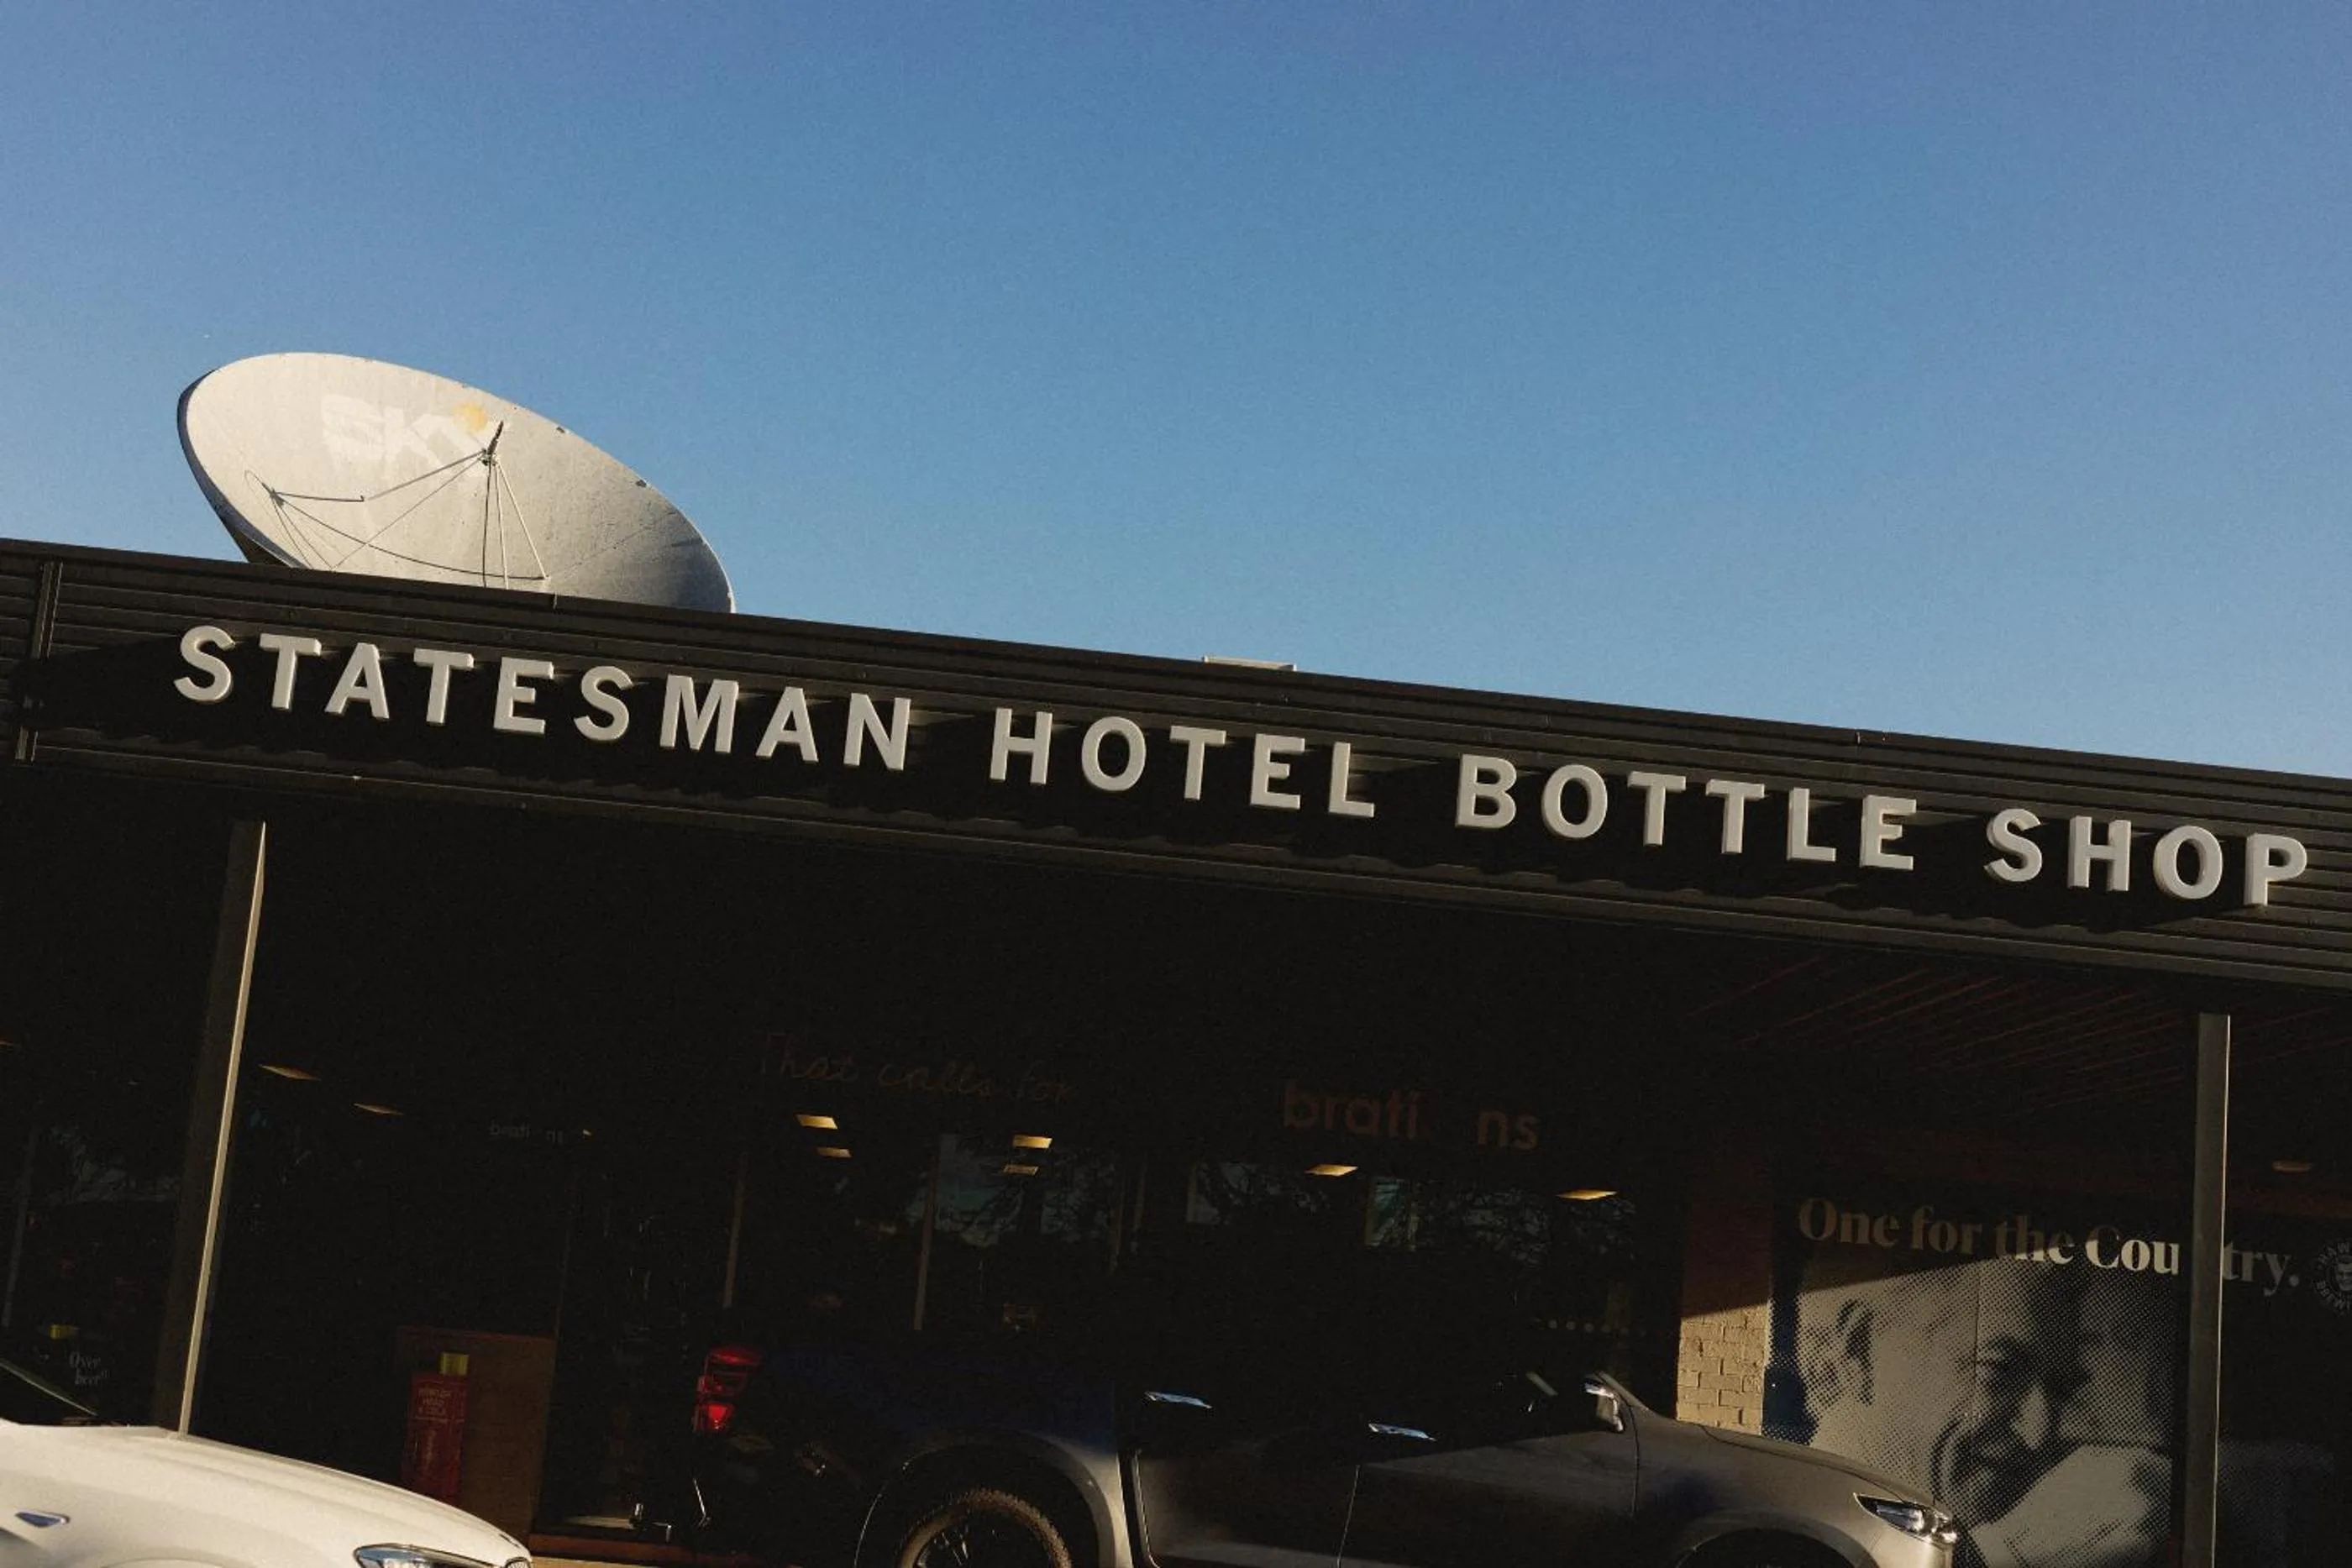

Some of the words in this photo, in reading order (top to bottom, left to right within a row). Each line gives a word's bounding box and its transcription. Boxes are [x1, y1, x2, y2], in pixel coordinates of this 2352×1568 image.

[173, 624, 913, 773] STATESMAN
[989, 706, 1377, 820] HOTEL
[1457, 753, 1919, 872] BOTTLE
[1986, 806, 2309, 908] SHOP
[759, 1032, 858, 1083] That
[877, 1060, 995, 1102] calls
[1798, 1197, 1899, 1247] One
[1911, 1204, 1982, 1256] for
[1994, 1214, 2075, 1265] the
[2084, 1224, 2300, 1298] Coutry.
